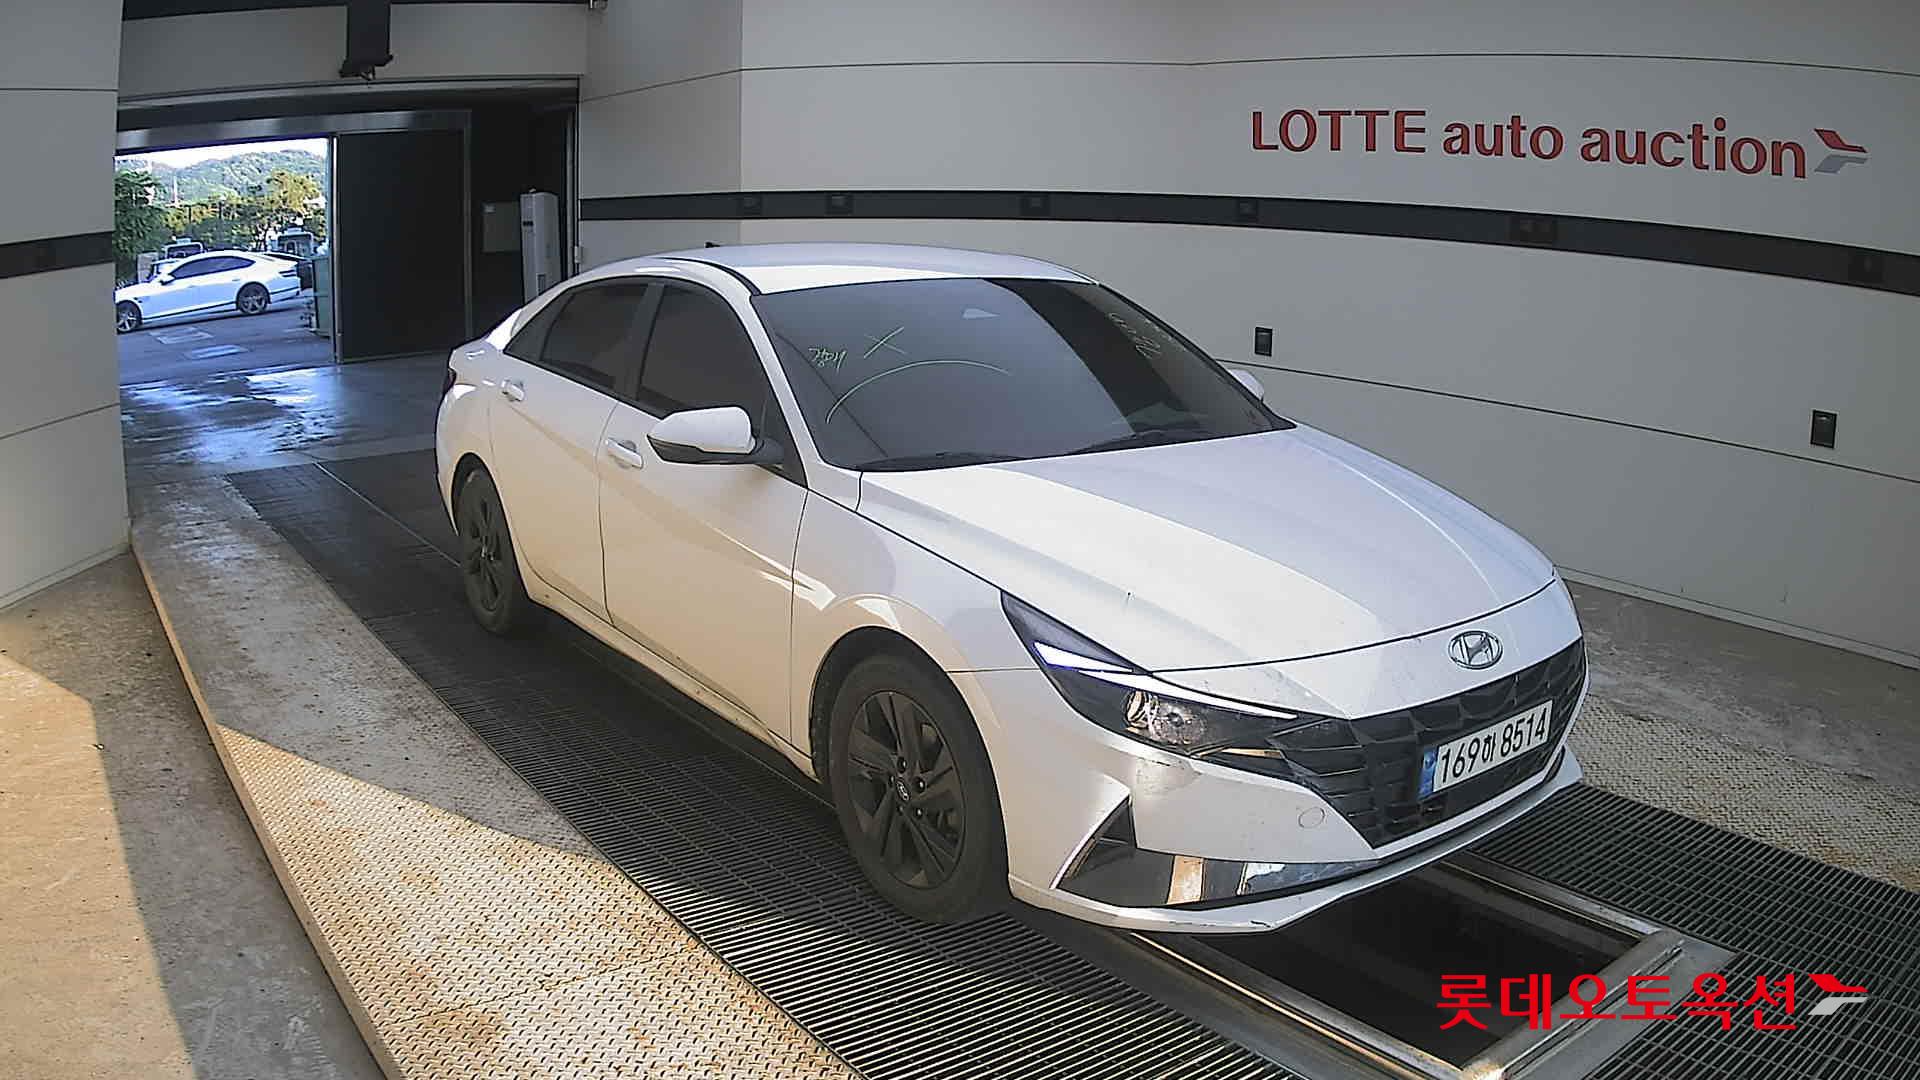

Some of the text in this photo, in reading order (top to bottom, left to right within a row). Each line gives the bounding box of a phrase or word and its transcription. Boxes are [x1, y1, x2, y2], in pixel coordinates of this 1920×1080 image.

[1252, 110, 1806, 178] LOTTE auto auction
[1441, 707, 1548, 784] 169하 8514
